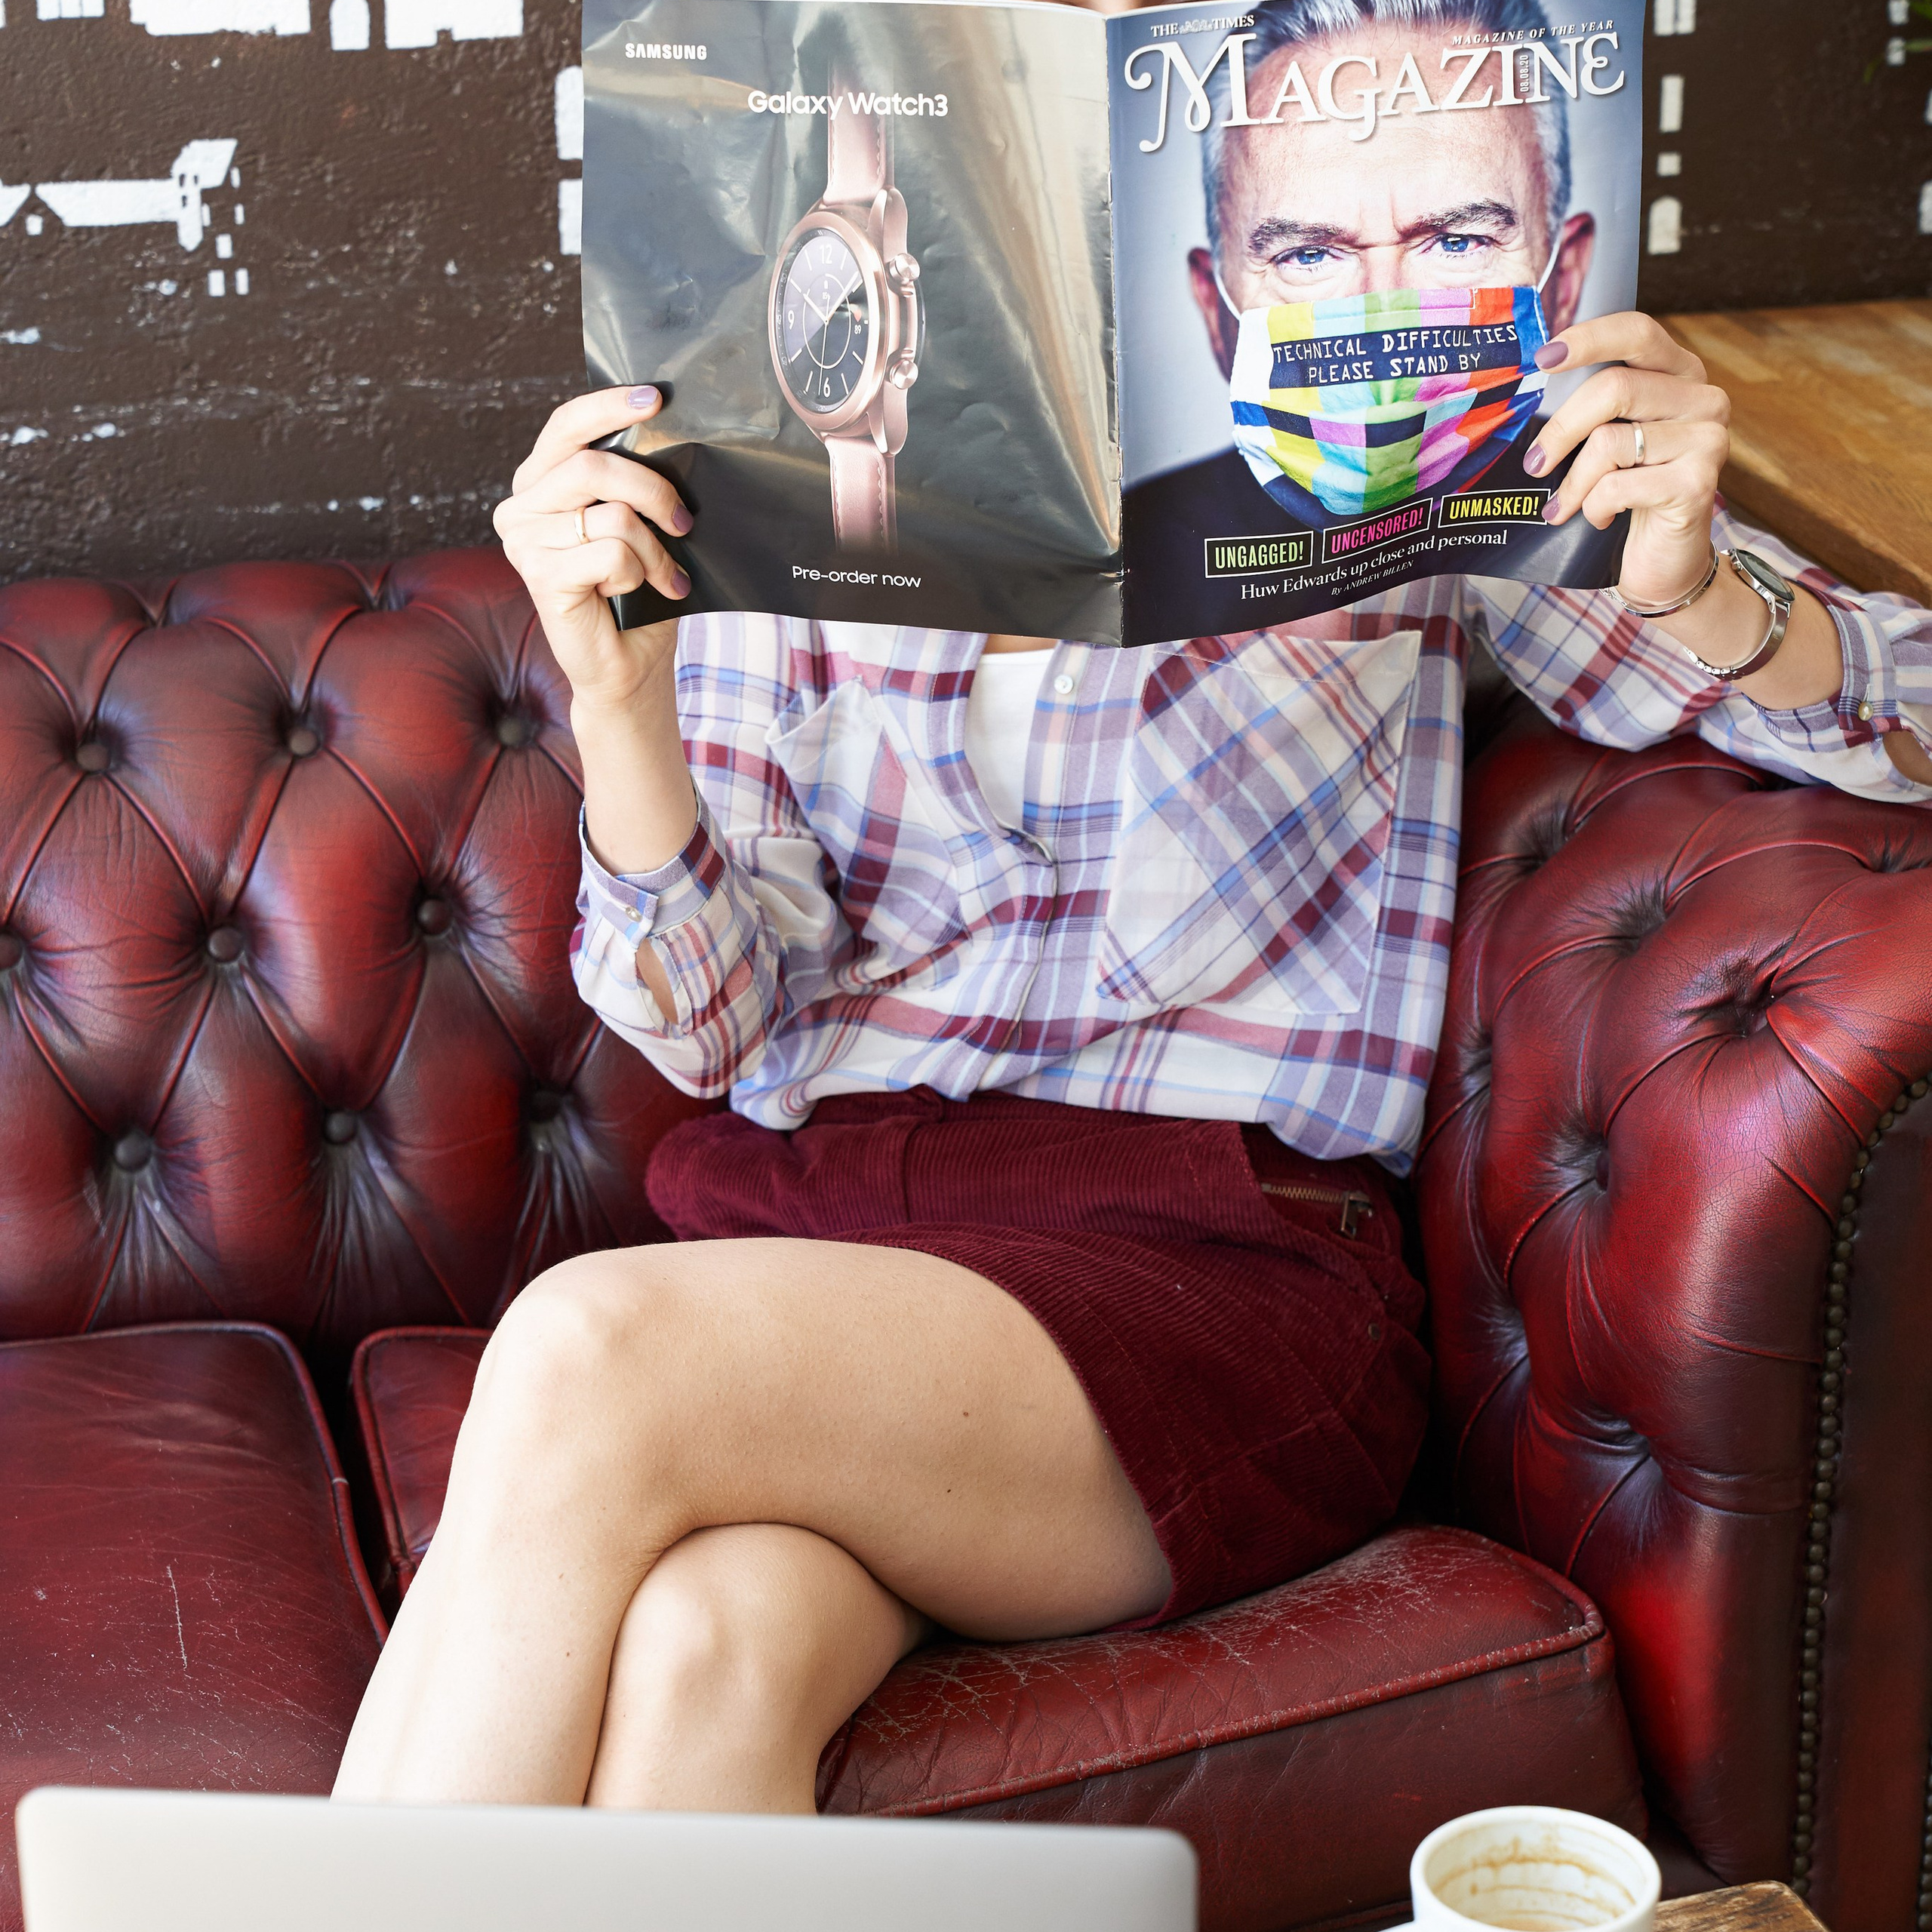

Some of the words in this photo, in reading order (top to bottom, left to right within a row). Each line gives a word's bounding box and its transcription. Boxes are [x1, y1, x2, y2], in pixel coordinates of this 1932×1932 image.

[1151, 23, 1179, 37] THE
[1211, 14, 1255, 29] TIMES
[1452, 30, 1524, 45] MAGAZINE
[1529, 28, 1546, 38] OF
[1551, 24, 1576, 36] THE
[1581, 20, 1614, 32] YEAR
[625, 42, 708, 60] SAMSUNG
[1519, 54, 1530, 93] 08.08.20
[747, 91, 844, 120] Galaxy
[848, 91, 949, 117] Watch3
[820, 244, 832, 264] 12
[788, 310, 795, 330] 9
[854, 325, 862, 334] 89
[1273, 338, 1367, 364] TECHNICAL
[1382, 325, 1518, 353] DIFFICULTIES
[1308, 361, 1374, 383] PLEASE
[1390, 355, 1448, 377] STAND
[1460, 352, 1481, 369] BY
[823, 377, 830, 398] 6
[1449, 496, 1540, 519] UNMASKED!
[1331, 507, 1423, 554] UNCENSORED!
[1214, 540, 1304, 569] UNGAGGED!
[1241, 582, 1279, 600] Huw
[1283, 567, 1348, 593] Edwards
[1350, 562, 1368, 577] up
[1371, 549, 1404, 568] close
[1407, 535, 1435, 555] and
[1437, 529, 1508, 551] personal
[792, 565, 878, 584] Pre-order
[882, 574, 921, 588] now
[1331, 585, 1343, 596] By
[1343, 571, 1382, 592] ANDREW
[1383, 560, 1414, 578] BILLEN
